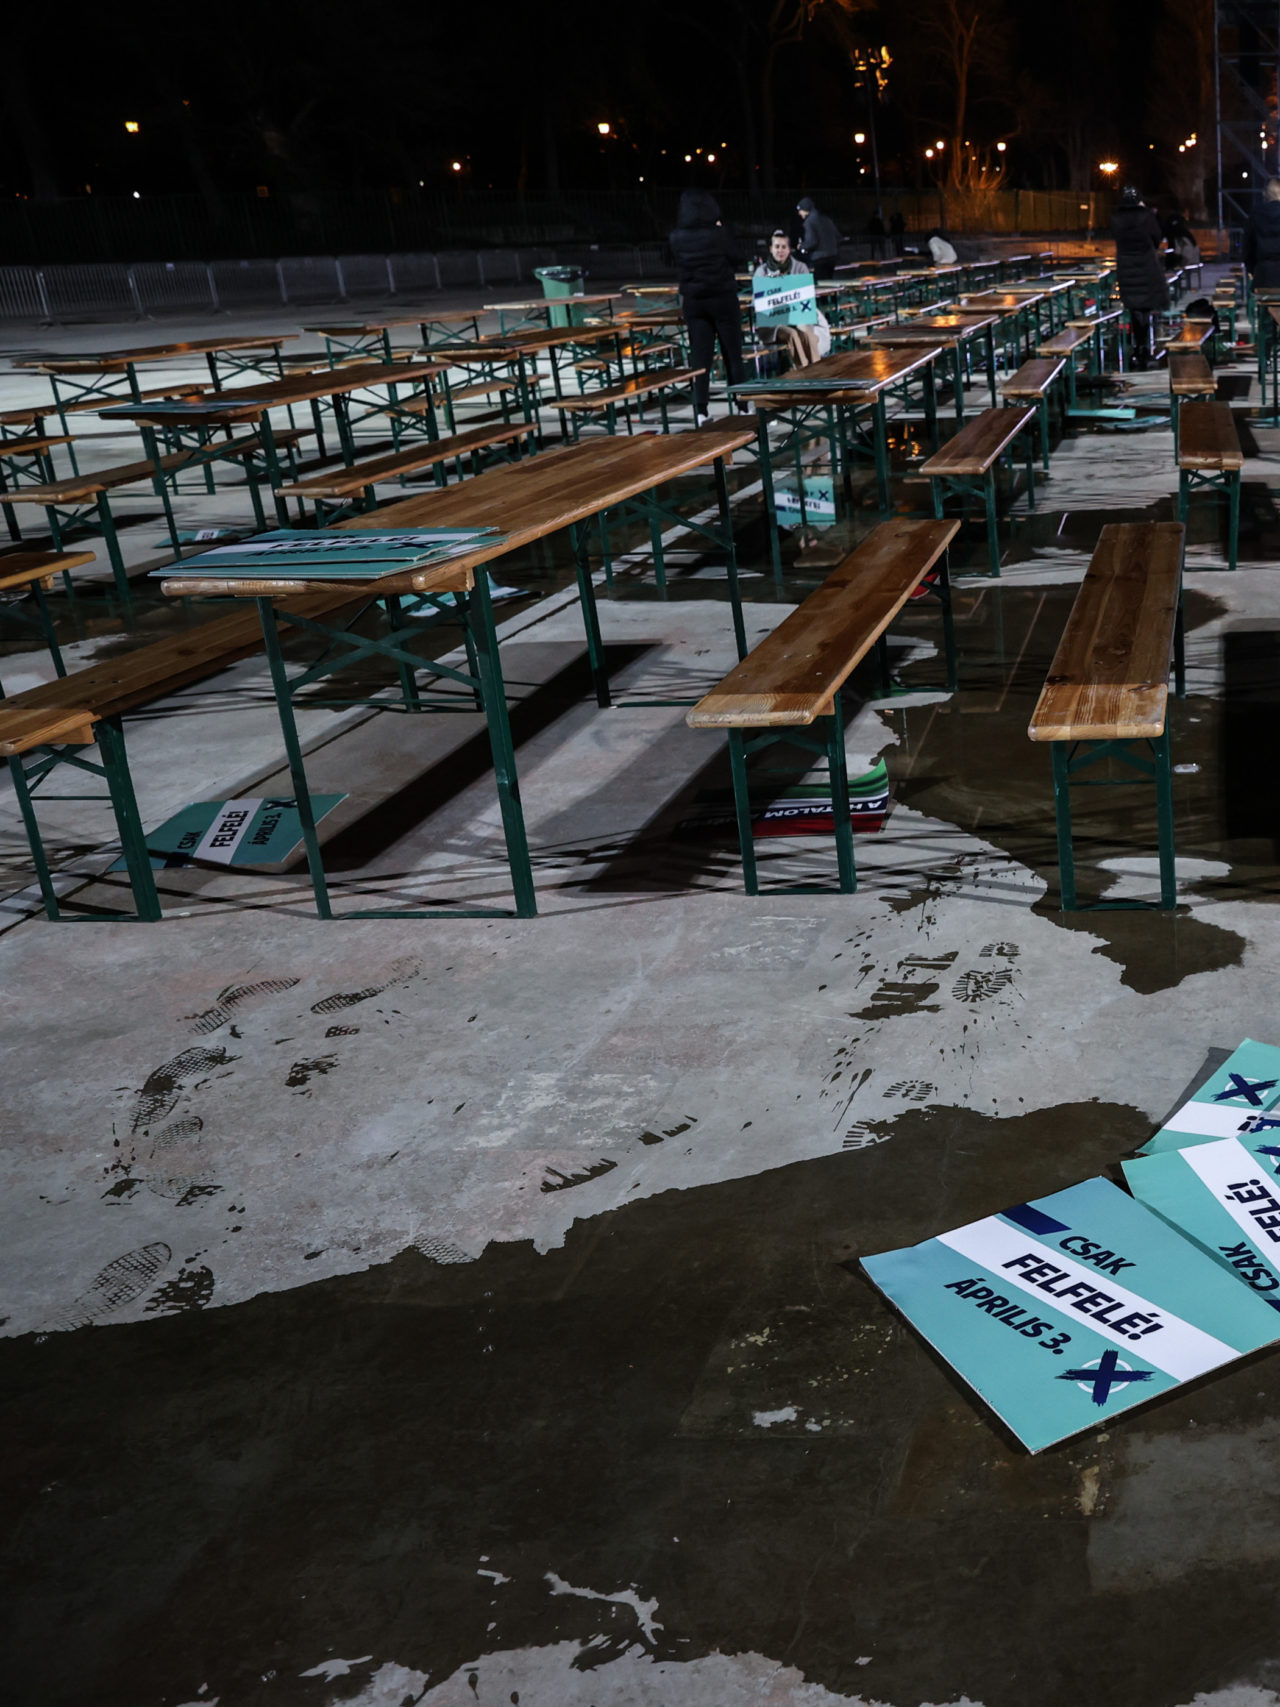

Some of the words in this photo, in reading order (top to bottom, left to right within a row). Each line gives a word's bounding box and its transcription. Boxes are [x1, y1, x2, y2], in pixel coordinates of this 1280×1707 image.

[269, 536, 420, 548] FELFELÉ!
[763, 803, 863, 818] HTALOM
[867, 801, 883, 809] A
[177, 830, 202, 850] CSAK
[210, 810, 249, 848] FELFELÉ!
[248, 819, 277, 845] ÁPRILIS
[1059, 1236, 1136, 1276] CSAK
[1218, 1241, 1280, 1291] CSAK
[1001, 1253, 1164, 1340] FELFELÉ!
[944, 1278, 1054, 1338] ÁPRILIS
[1038, 1332, 1072, 1355] 3.
